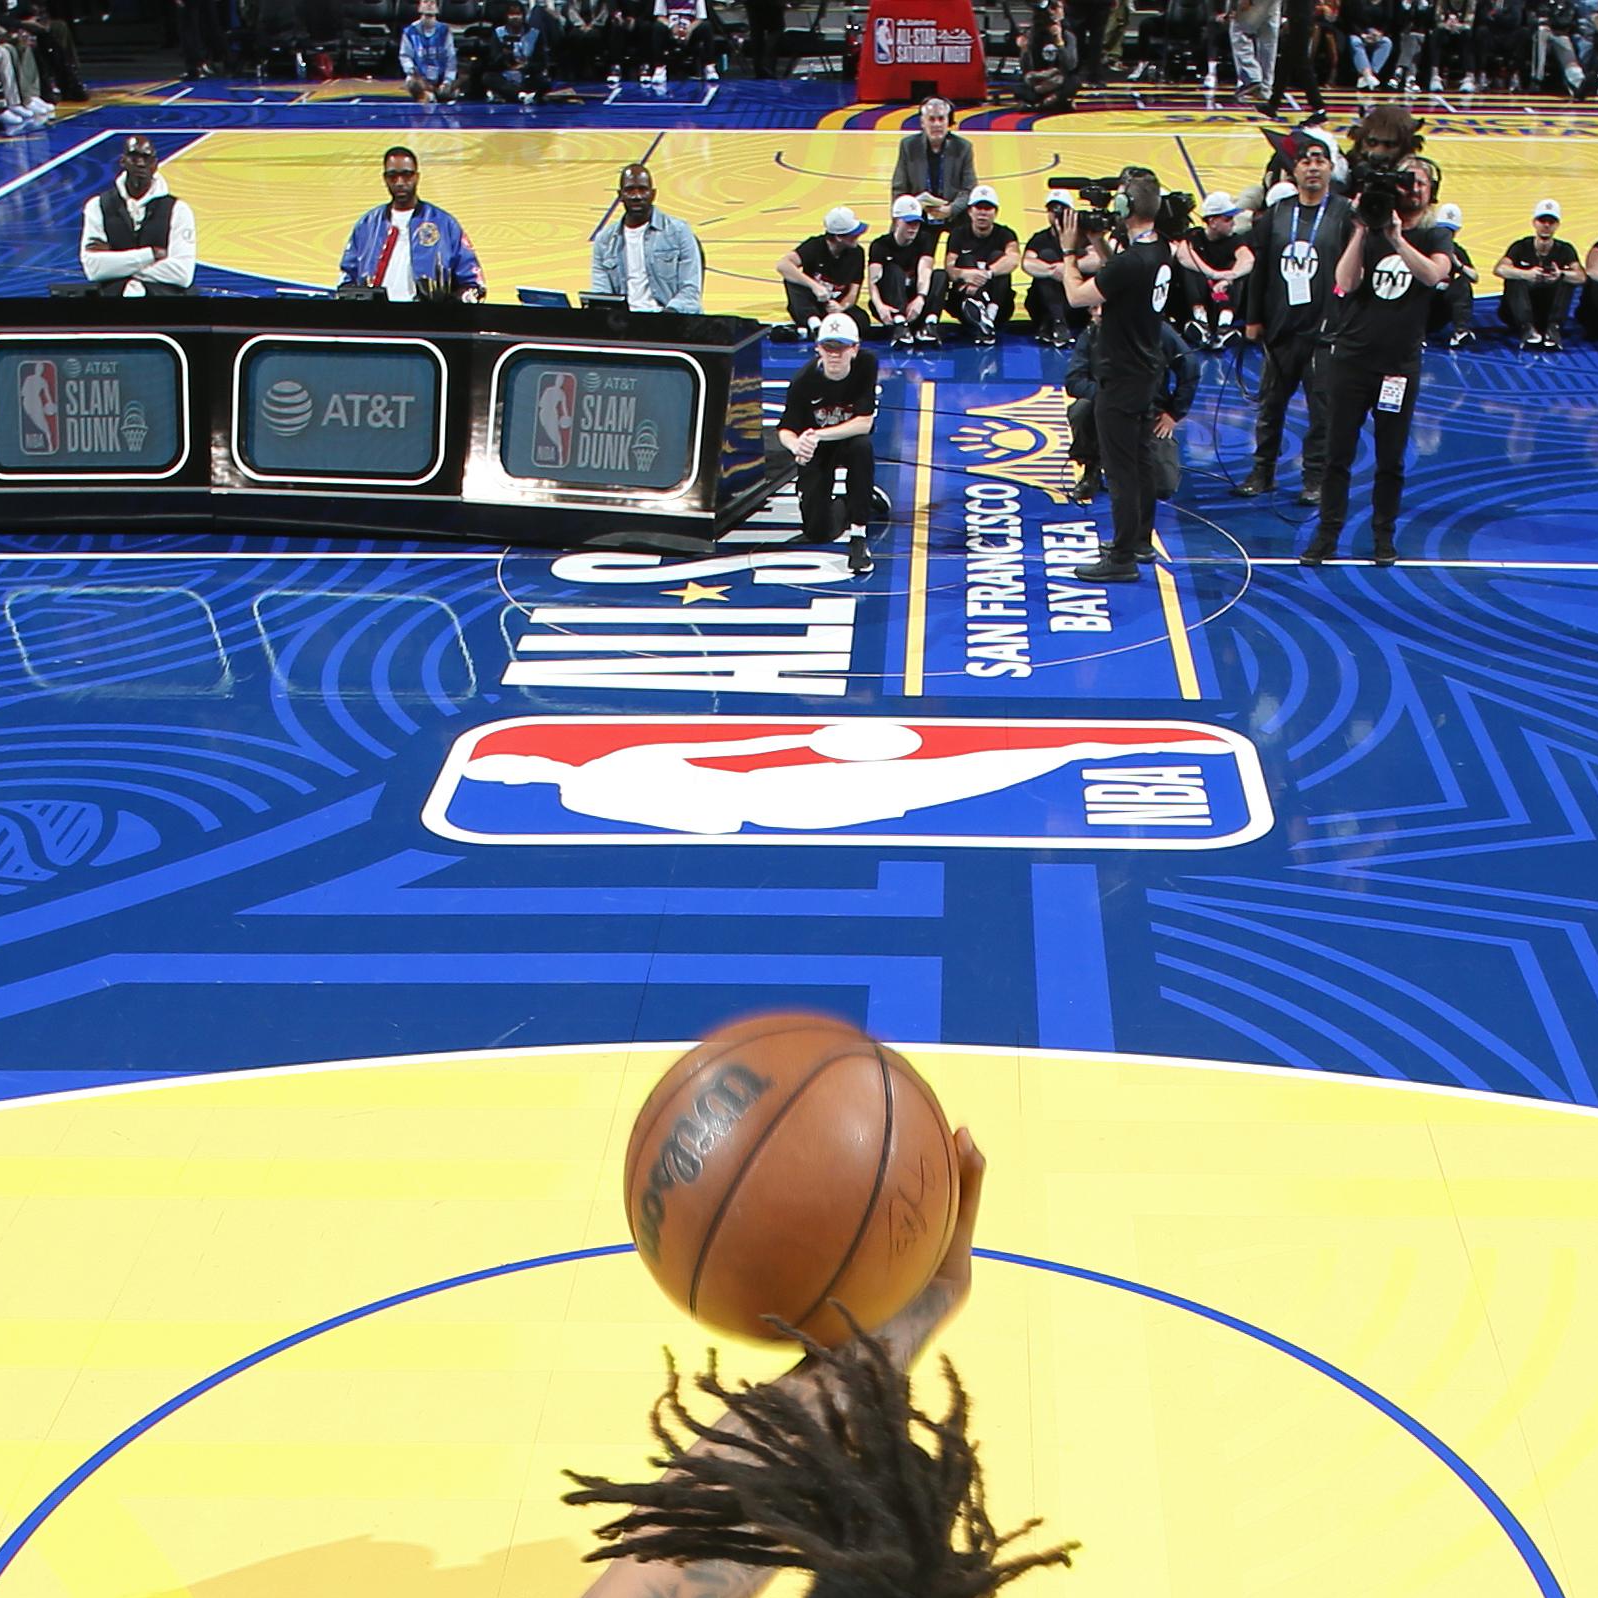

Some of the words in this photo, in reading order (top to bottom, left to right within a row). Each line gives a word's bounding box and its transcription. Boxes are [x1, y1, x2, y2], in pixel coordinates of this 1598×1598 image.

[1373, 270, 1412, 288] TNT
[84, 361, 118, 375] AT&T
[603, 376, 637, 391] AT&T
[65, 379, 121, 416] SLAM
[321, 393, 415, 429] AT&T
[580, 394, 636, 433] SLAM
[66, 417, 121, 453] DUNK
[576, 432, 632, 471] DUNK
[964, 483, 1027, 618] FRANCISCO
[1042, 521, 1103, 579] AREA
[1047, 582, 1113, 633] BAY
[965, 622, 1033, 678] SAN
[1081, 765, 1213, 826] NBA
[639, 1063, 776, 1266] Wilson
